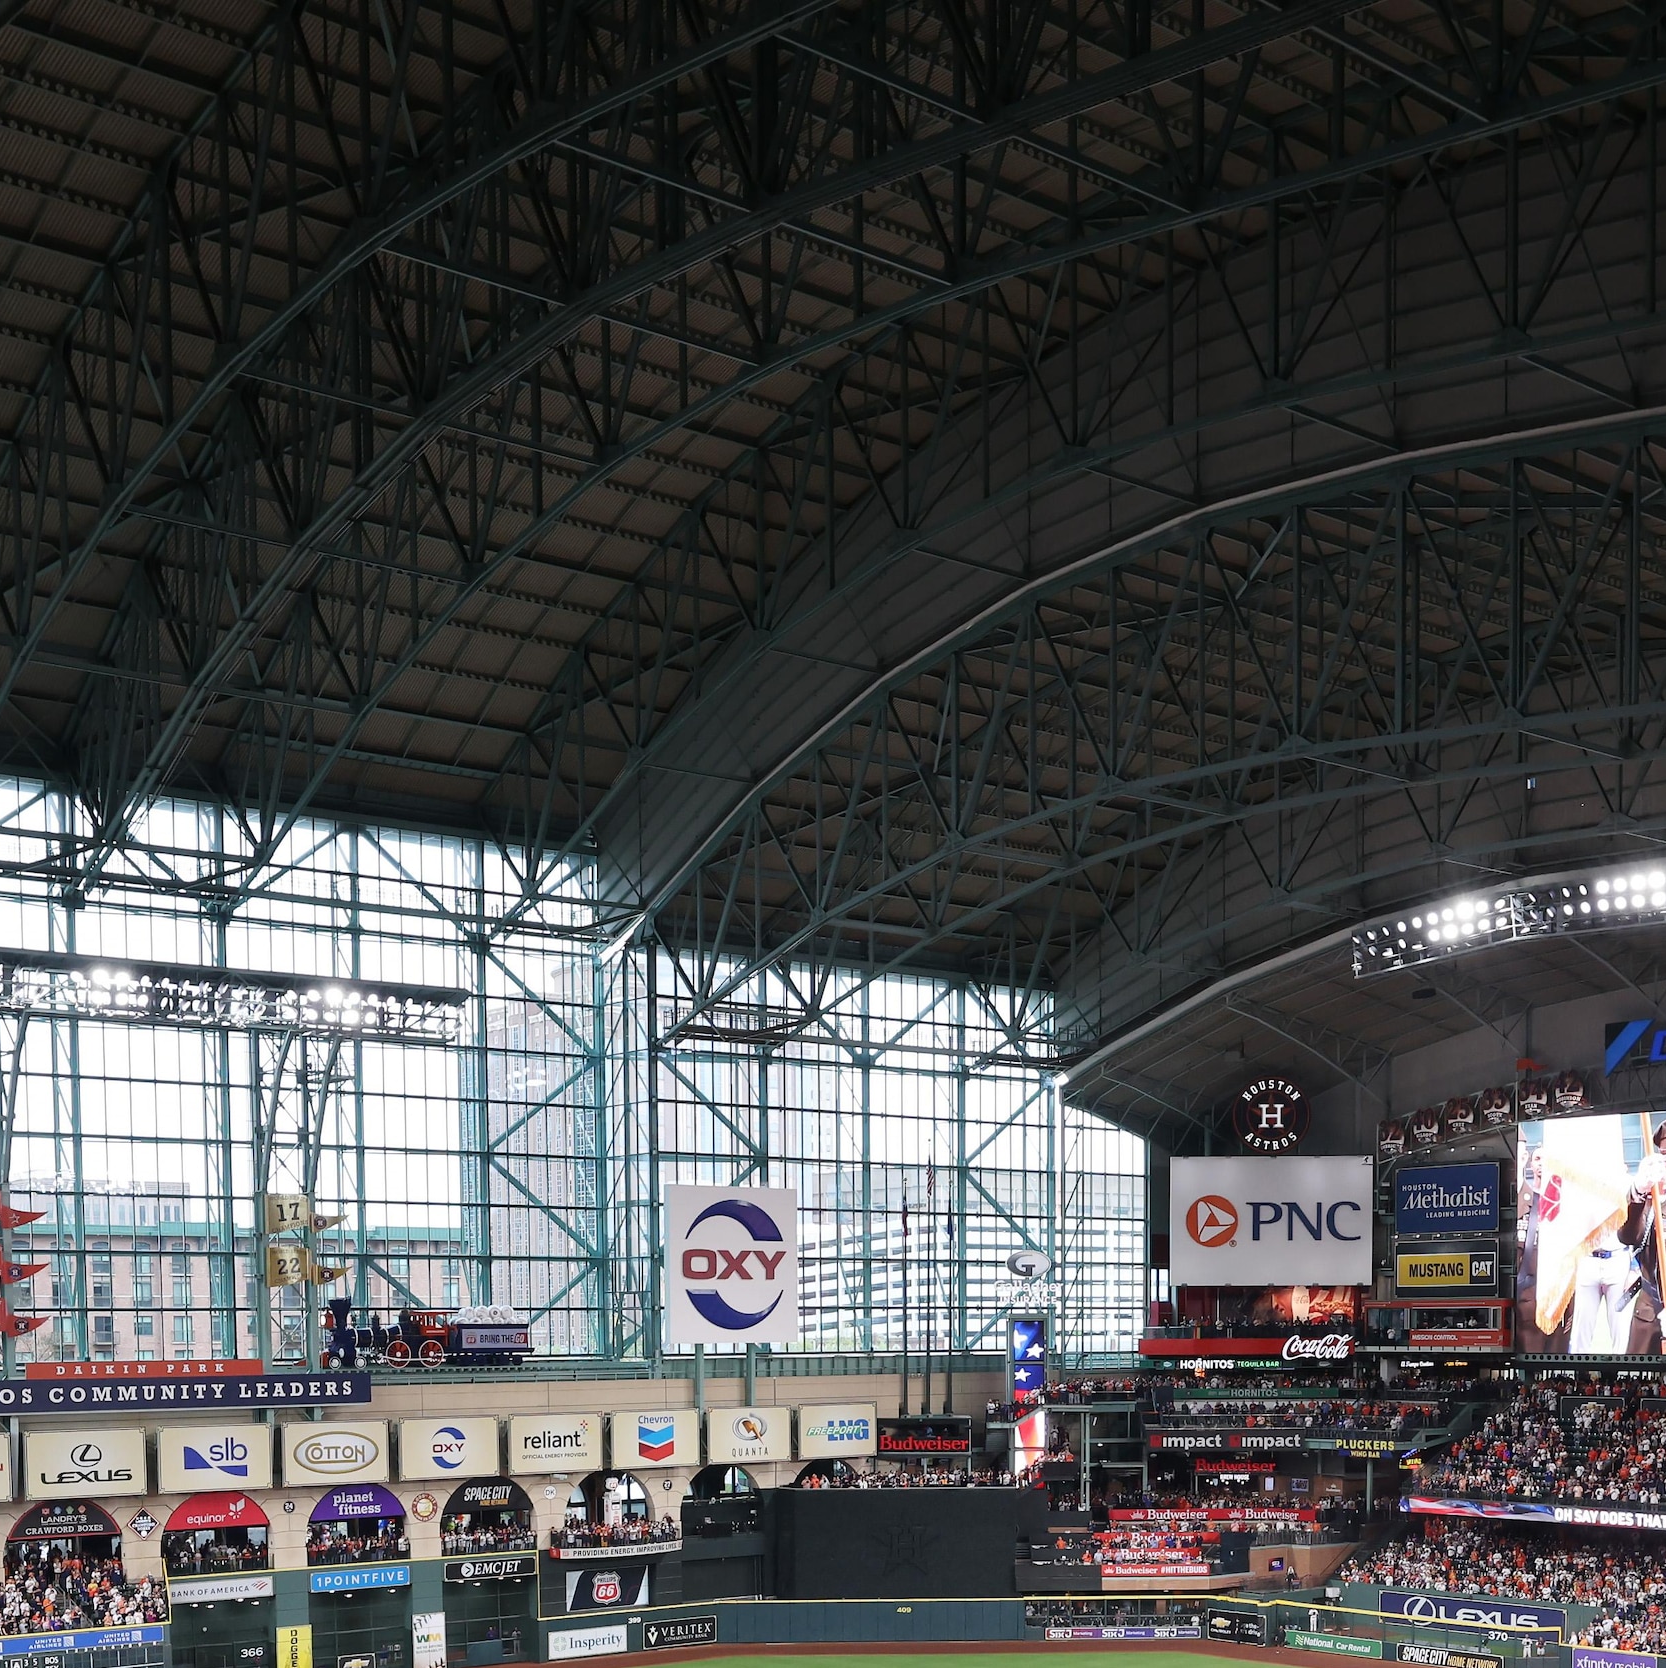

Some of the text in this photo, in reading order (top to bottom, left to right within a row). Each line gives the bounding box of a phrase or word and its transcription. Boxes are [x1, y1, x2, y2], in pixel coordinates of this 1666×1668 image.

[1241, 1079, 1302, 1102] HOUSTON
[1258, 1103, 1284, 1129] H
[1244, 1131, 1299, 1151] ASTROS
[1402, 1183, 1437, 1192] HOUSTON
[1403, 1185, 1491, 1211] Methodist
[276, 1203, 300, 1222] 17
[1425, 1209, 1490, 1219] LEADING MEDICINE
[1246, 1201, 1361, 1242] PNC
[277, 1258, 301, 1275] 22
[681, 1249, 787, 1281] OXY
[1409, 1260, 1493, 1278] MUSTANG CAT
[1282, 1333, 1354, 1361] Coca-Cola
[55, 1363, 225, 1375] DAIKIN PARK
[48, 1383, 226, 1404] COMMUNITY
[239, 1380, 353, 1398] LEADERS
[638, 1415, 675, 1424] Chevron
[807, 1418, 870, 1441] FREEPORT LNG
[432, 1443, 465, 1452] OXY
[524, 1430, 582, 1450] reliant
[880, 1435, 969, 1451] Budweiser
[1162, 1434, 1222, 1450] impact
[1241, 1434, 1301, 1450] impact
[1336, 1438, 1395, 1451] PLUCKERS
[209, 1437, 248, 1461] slb
[305, 1442, 366, 1464] COTTON
[731, 1447, 770, 1457] QUANTA
[1195, 1459, 1276, 1473] Budweiser
[40, 1469, 133, 1485] LEXUS
[333, 1491, 374, 1506] planet
[338, 1502, 381, 1515] fitness
[1147, 1508, 1209, 1520] Budweiser
[1245, 1508, 1299, 1521] Budweiser
[40, 1514, 87, 1525] LANDRY'S
[186, 1513, 226, 1525] equinor
[1554, 1507, 1571, 1523] OH
[1573, 1509, 1598, 1525] SAY
[1600, 1510, 1634, 1526] DOES
[25, 1523, 104, 1536] CRAWFORD BOXES
[474, 1560, 521, 1576] EMCJET
[1115, 1565, 1208, 1575] Budweiser #HITTHEBUDS
[316, 1571, 404, 1588] 1POINTFIVE
[171, 1585, 250, 1598] BANK OF AMERICA
[598, 1585, 615, 1597] 66
[896, 1606, 912, 1614] 409
[1440, 1606, 1539, 1629] LEXUS
[661, 1622, 711, 1637] VERITEX
[1488, 1630, 1509, 1641] 370
[416, 1633, 442, 1643] WM
[570, 1634, 623, 1649] Insperity
[1303, 1636, 1371, 1653] National Car Rental
[239, 1646, 264, 1658] 366
[1402, 1646, 1430, 1663] SPACE
[1429, 1649, 1448, 1665] CITY
[1447, 1655, 1466, 1668] HOME
[45, 1656, 59, 1664] BOS
